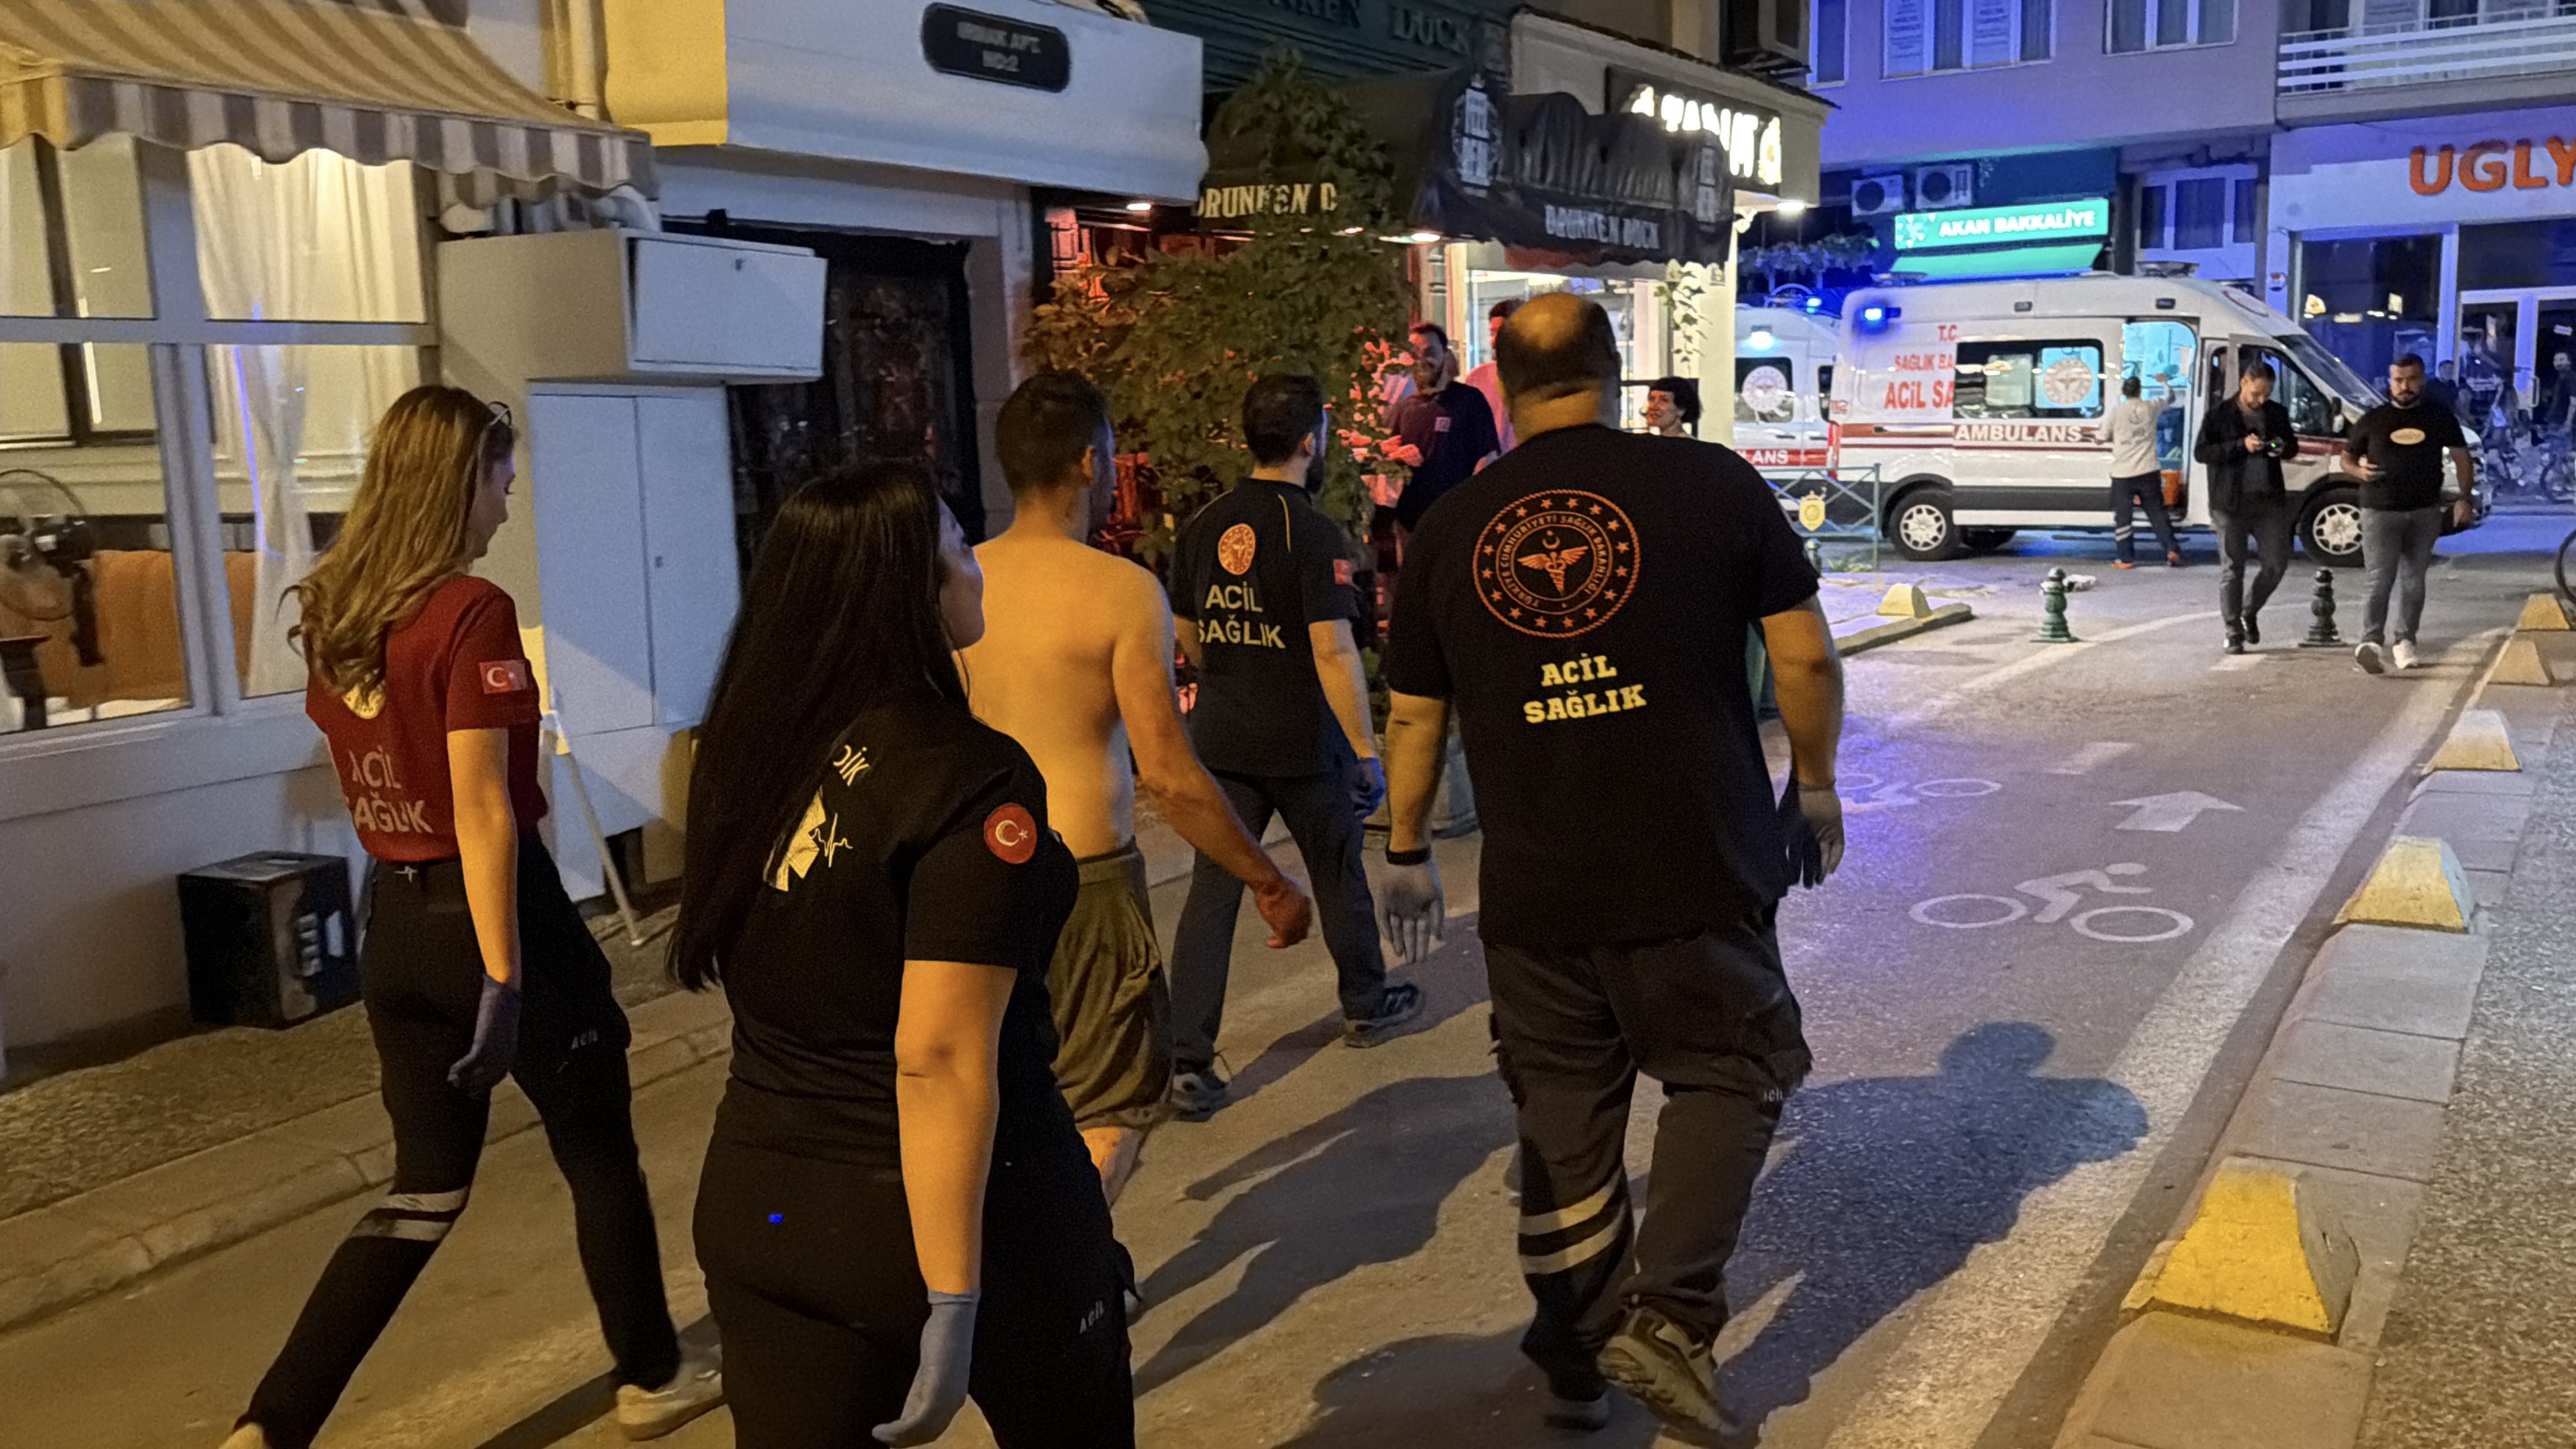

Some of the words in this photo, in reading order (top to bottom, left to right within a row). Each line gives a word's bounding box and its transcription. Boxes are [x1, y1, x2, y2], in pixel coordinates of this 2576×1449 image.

[2409, 135, 2576, 195] UGLY
[1939, 217, 1991, 238] AKAN
[1993, 208, 2095, 233] BAKKALİYE
[1956, 424, 2082, 442] AMBULANS
[1205, 581, 1263, 613] ACİL
[1541, 653, 1617, 686] ACİL
[1523, 684, 1647, 724] SAĞLIK
[345, 790, 433, 834] AĞLIK
